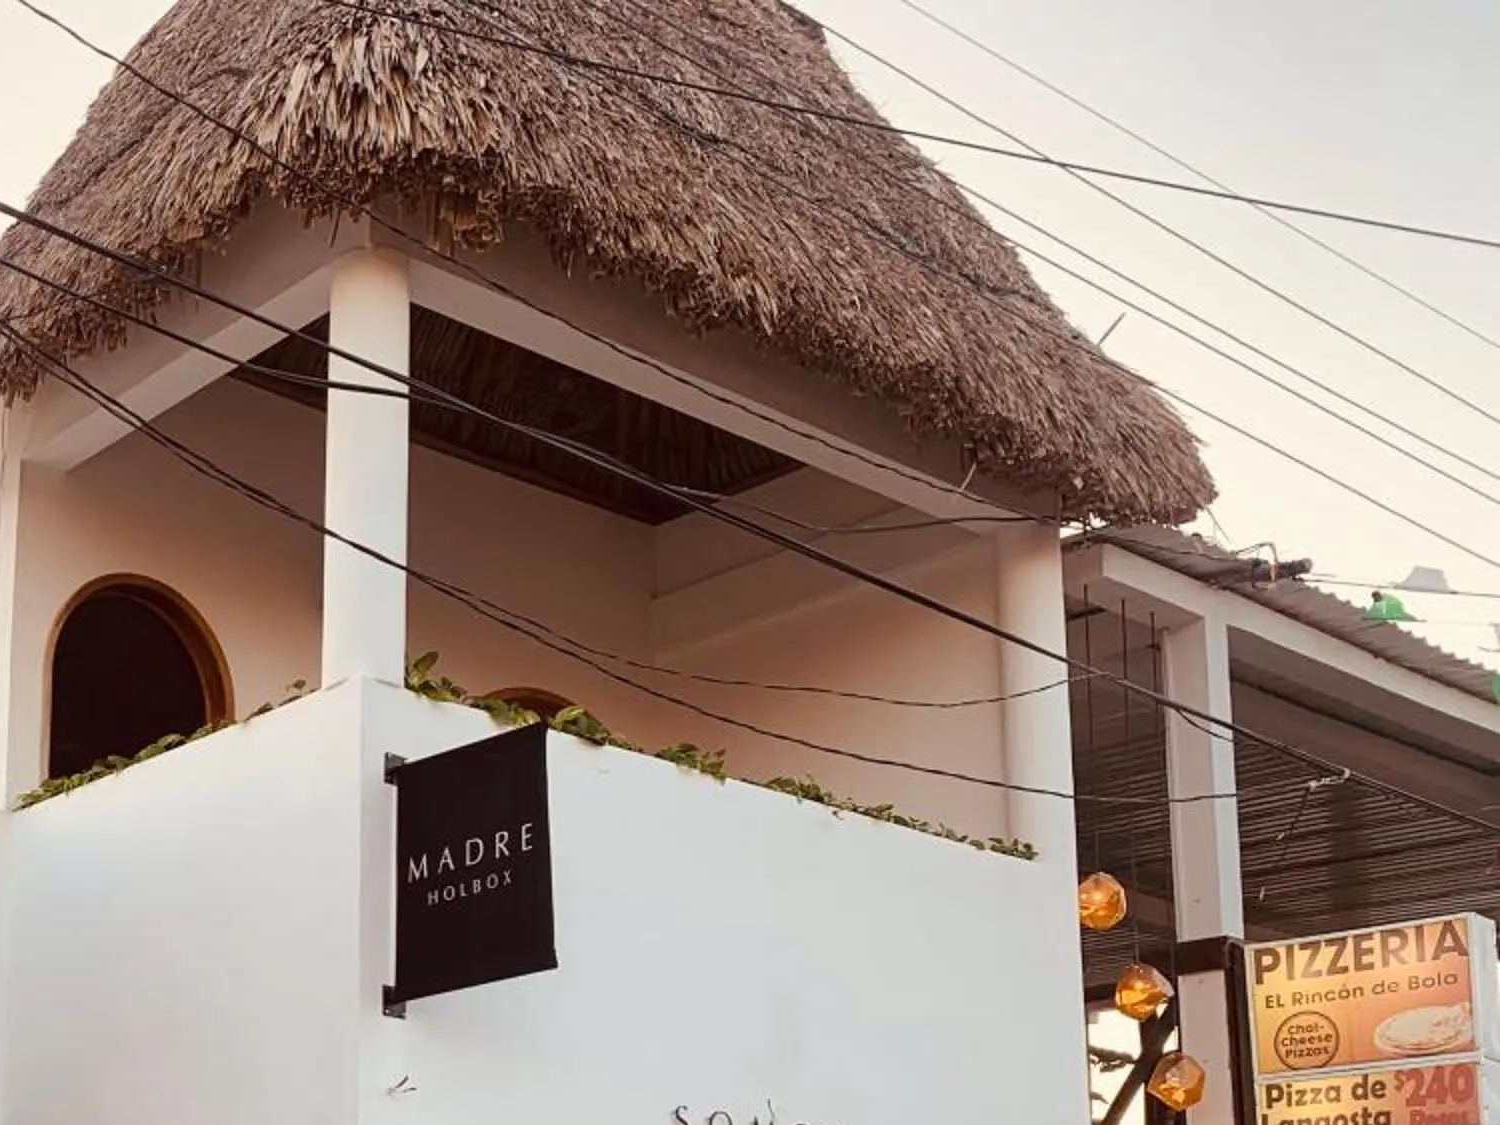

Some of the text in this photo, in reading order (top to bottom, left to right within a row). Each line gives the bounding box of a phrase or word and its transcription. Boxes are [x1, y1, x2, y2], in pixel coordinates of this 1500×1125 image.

[407, 823, 533, 883] MADRE
[427, 869, 513, 905] HOLBOX
[1254, 919, 1469, 985] PIZZERIA
[1291, 984, 1365, 1007] Rincón
[1371, 979, 1399, 995] de
[1264, 1074, 1387, 1110] Pizza de
[1394, 1066, 1474, 1106] $240
